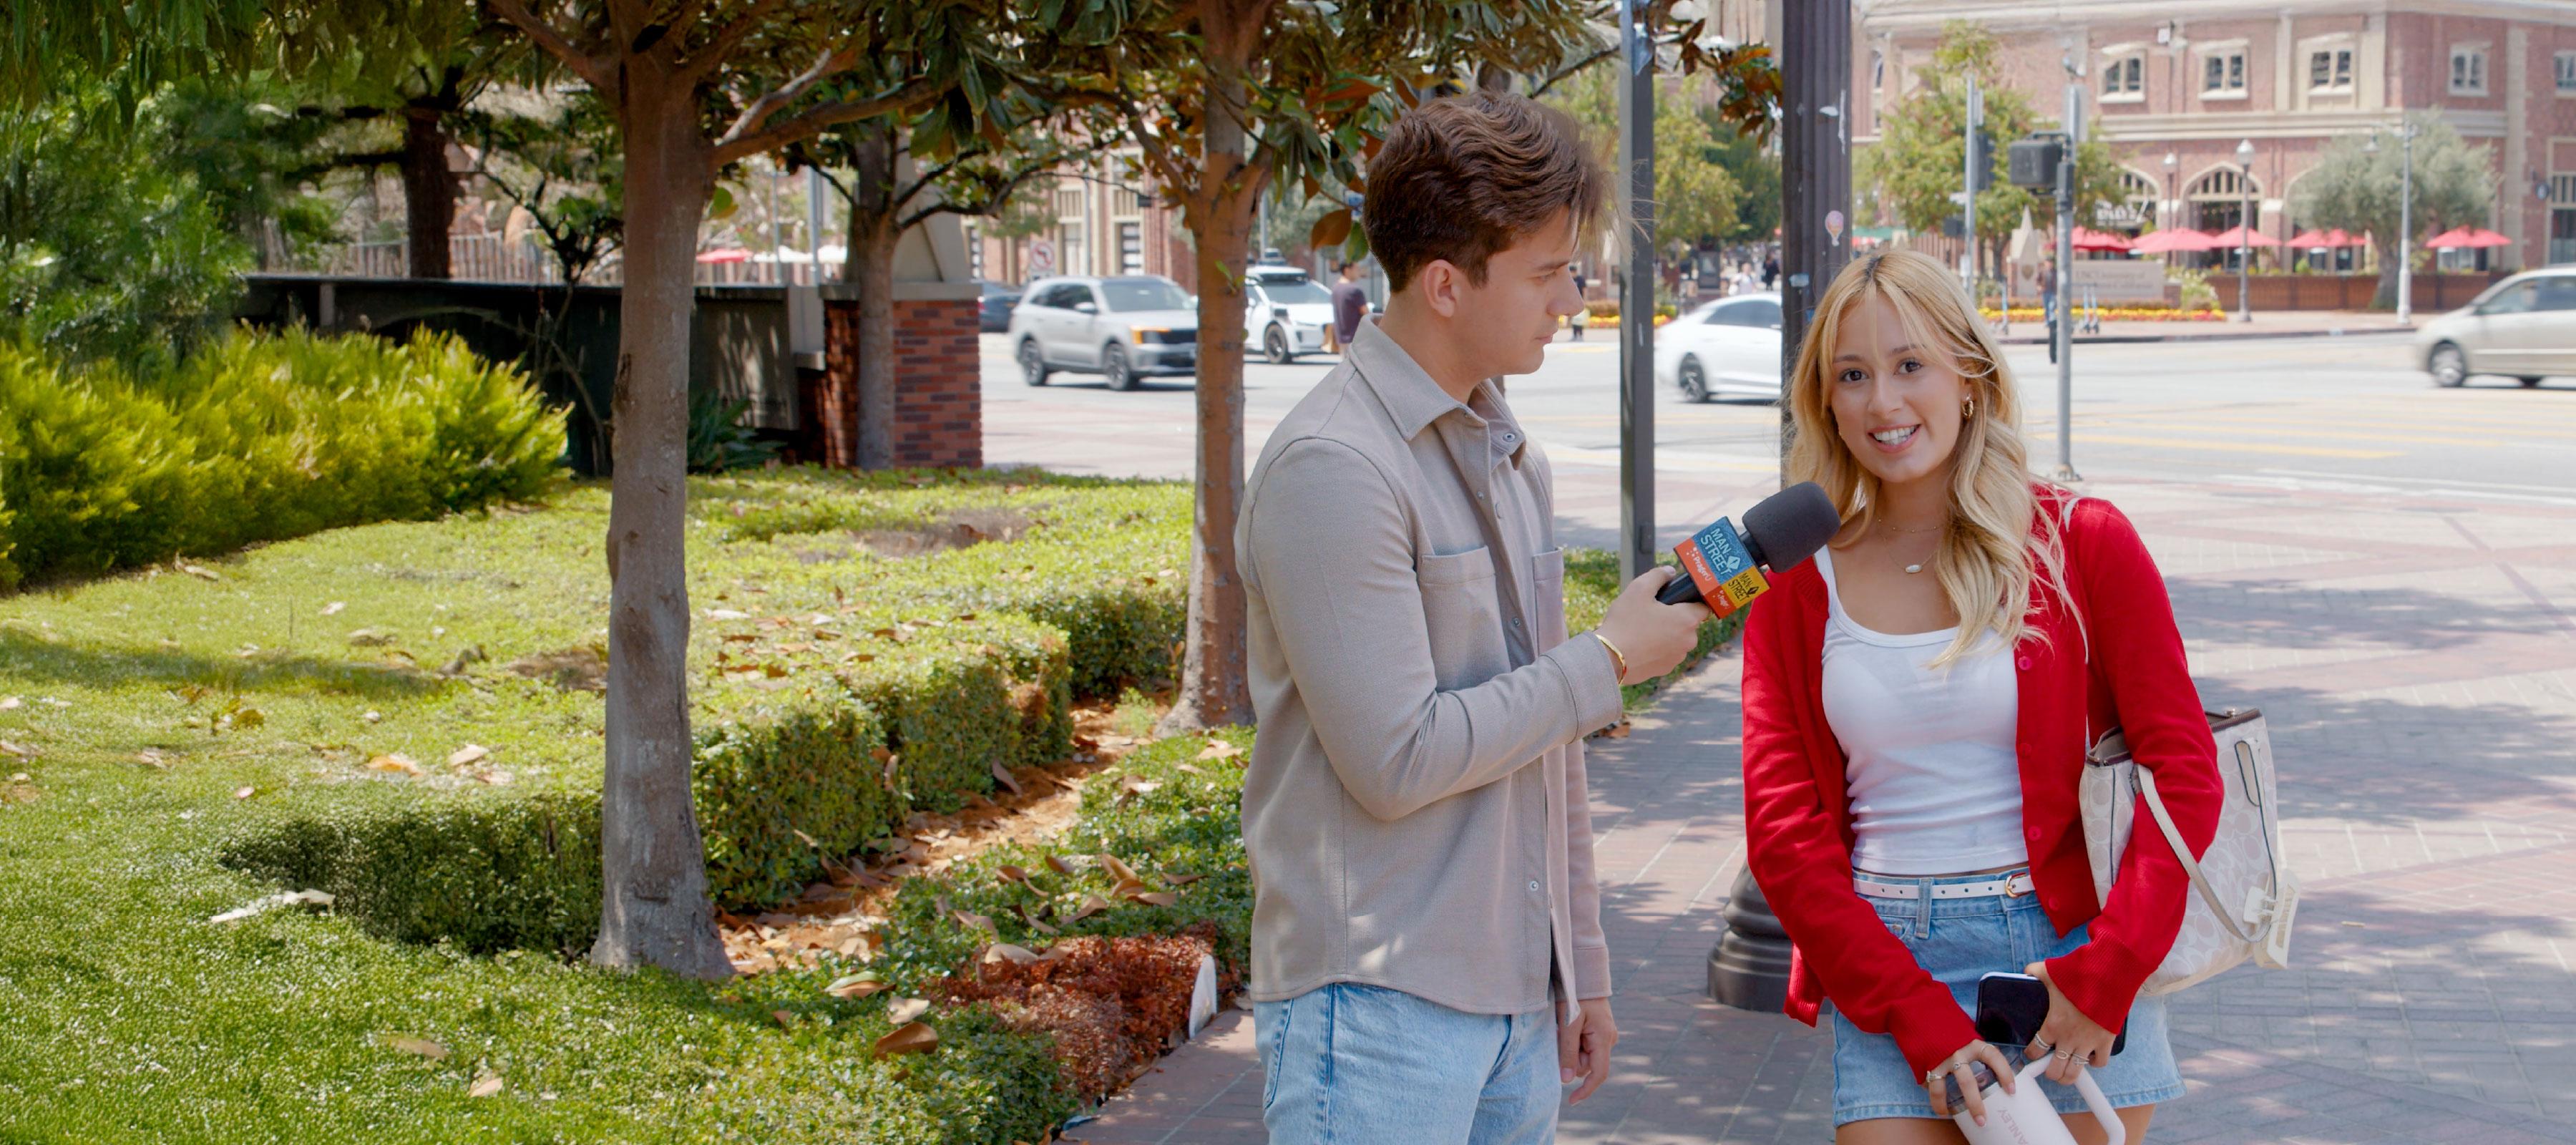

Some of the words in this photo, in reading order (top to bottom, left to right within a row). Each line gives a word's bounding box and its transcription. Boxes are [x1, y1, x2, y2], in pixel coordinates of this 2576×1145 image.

[1710, 528, 1732, 555] MAN
[1700, 535, 1732, 575] STREET
[1693, 556, 1712, 581] PragerU
[1739, 572, 1752, 588] MAN
[1728, 579, 1750, 601] STREET
